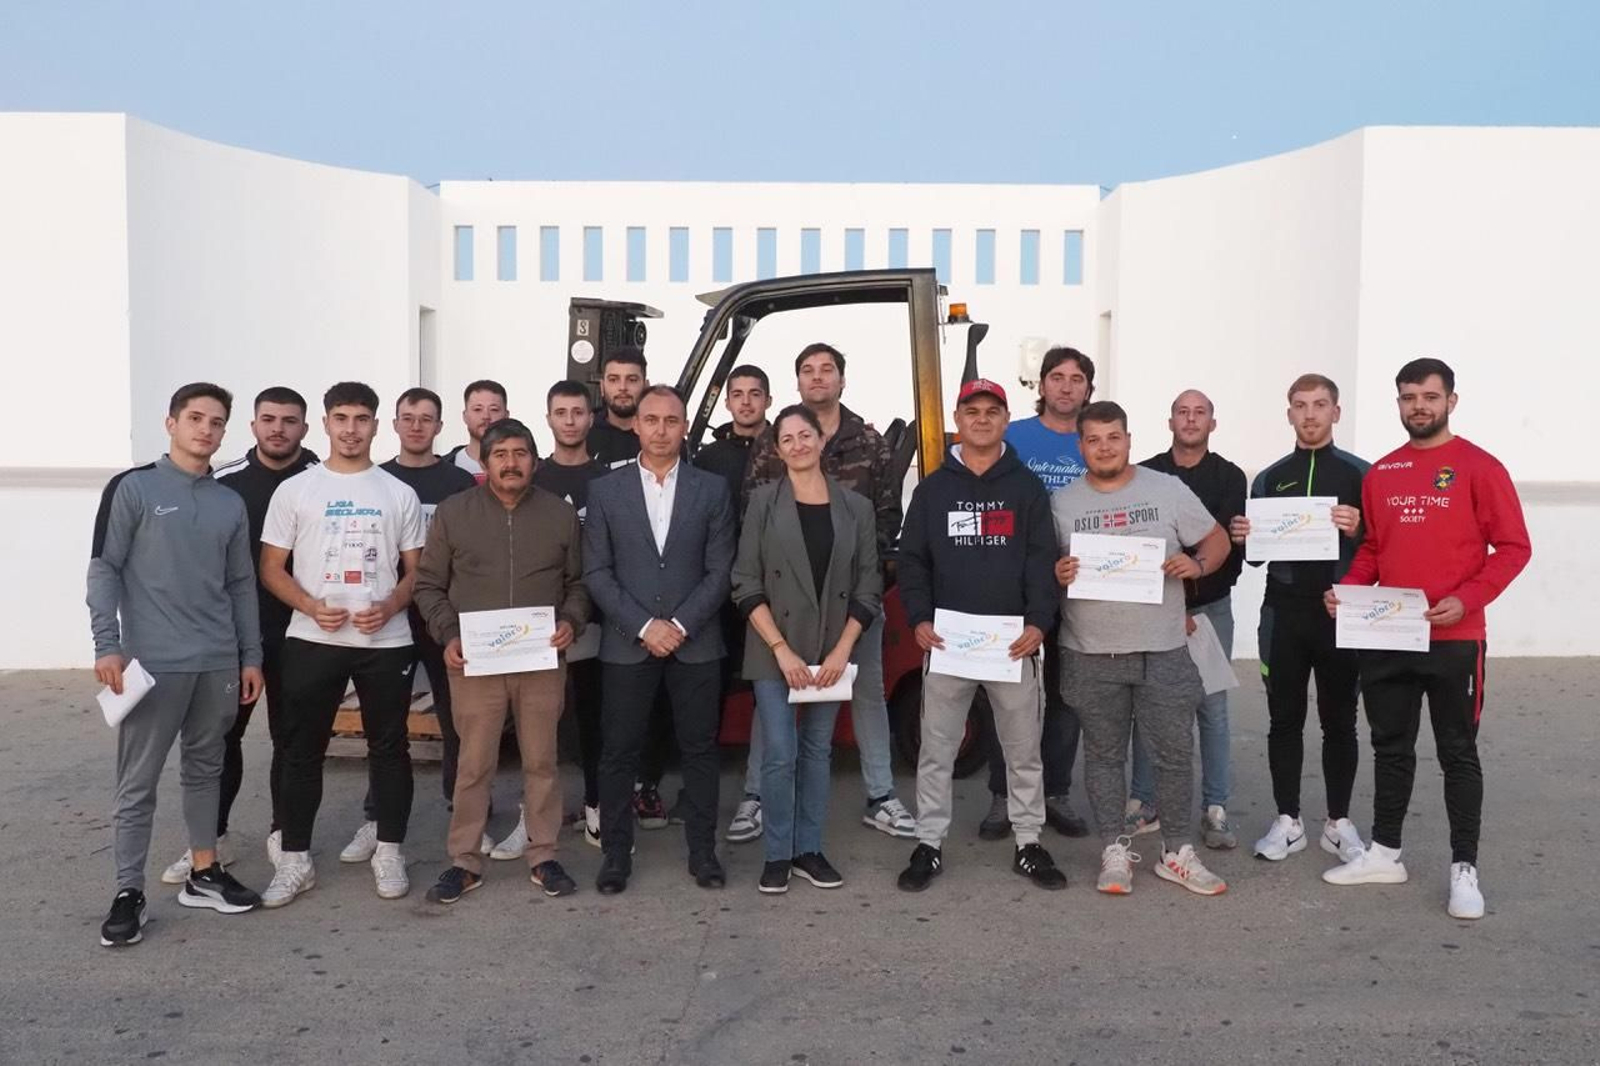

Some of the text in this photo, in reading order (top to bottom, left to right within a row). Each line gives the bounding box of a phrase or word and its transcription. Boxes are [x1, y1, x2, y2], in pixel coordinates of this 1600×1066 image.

[1378, 461, 1413, 470] GIVOVA
[957, 501, 1005, 511] TOMMY
[1387, 496, 1450, 508] YOUR TIME
[1074, 516, 1100, 532] OSLO
[1129, 507, 1159, 525] SPORT
[1400, 515, 1426, 523] SOCIETY
[955, 536, 1007, 546] HILFIGER
